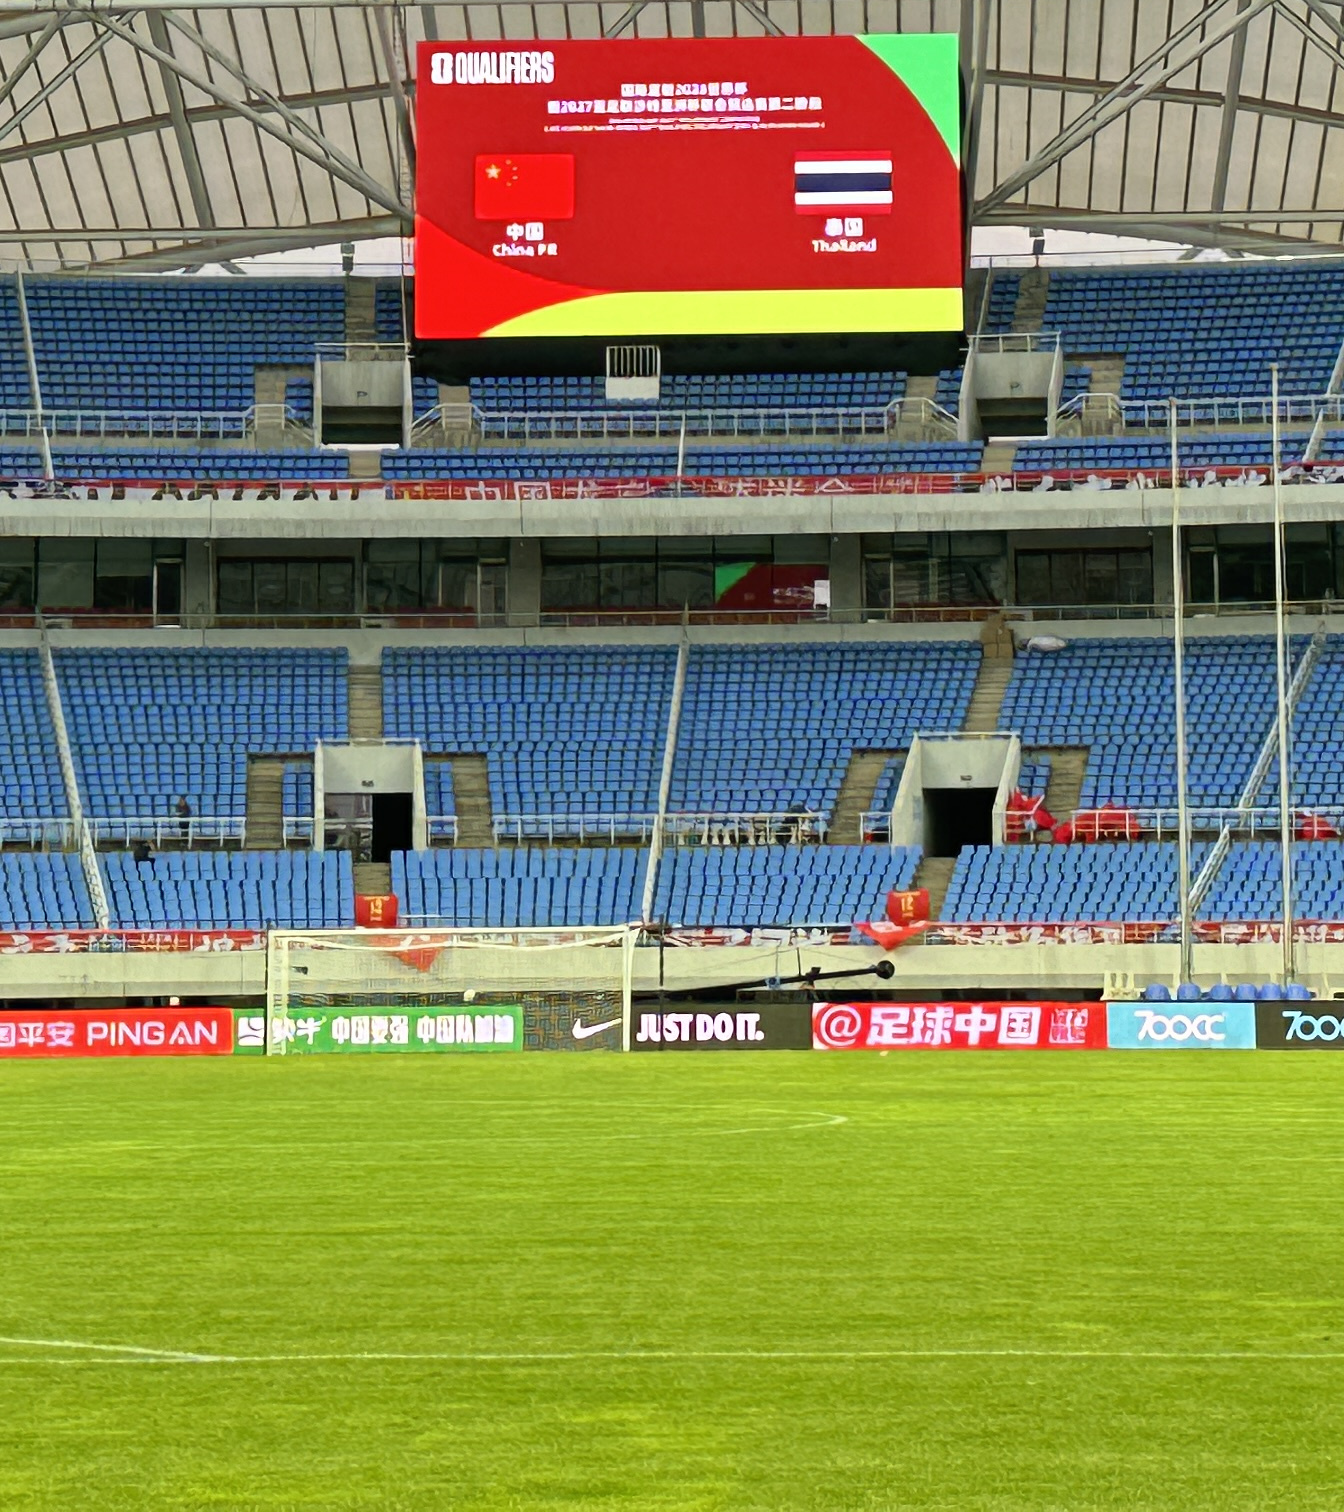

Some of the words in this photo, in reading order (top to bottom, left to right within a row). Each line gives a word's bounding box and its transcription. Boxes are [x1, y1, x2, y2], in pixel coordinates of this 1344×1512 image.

[455, 51, 554, 84] QUALIFIERS
[506, 222, 544, 241] 中国
[492, 242, 535, 257] China
[811, 238, 877, 253] Thailand
[636, 1012, 693, 1042] JUST
[696, 1012, 733, 1041] DO
